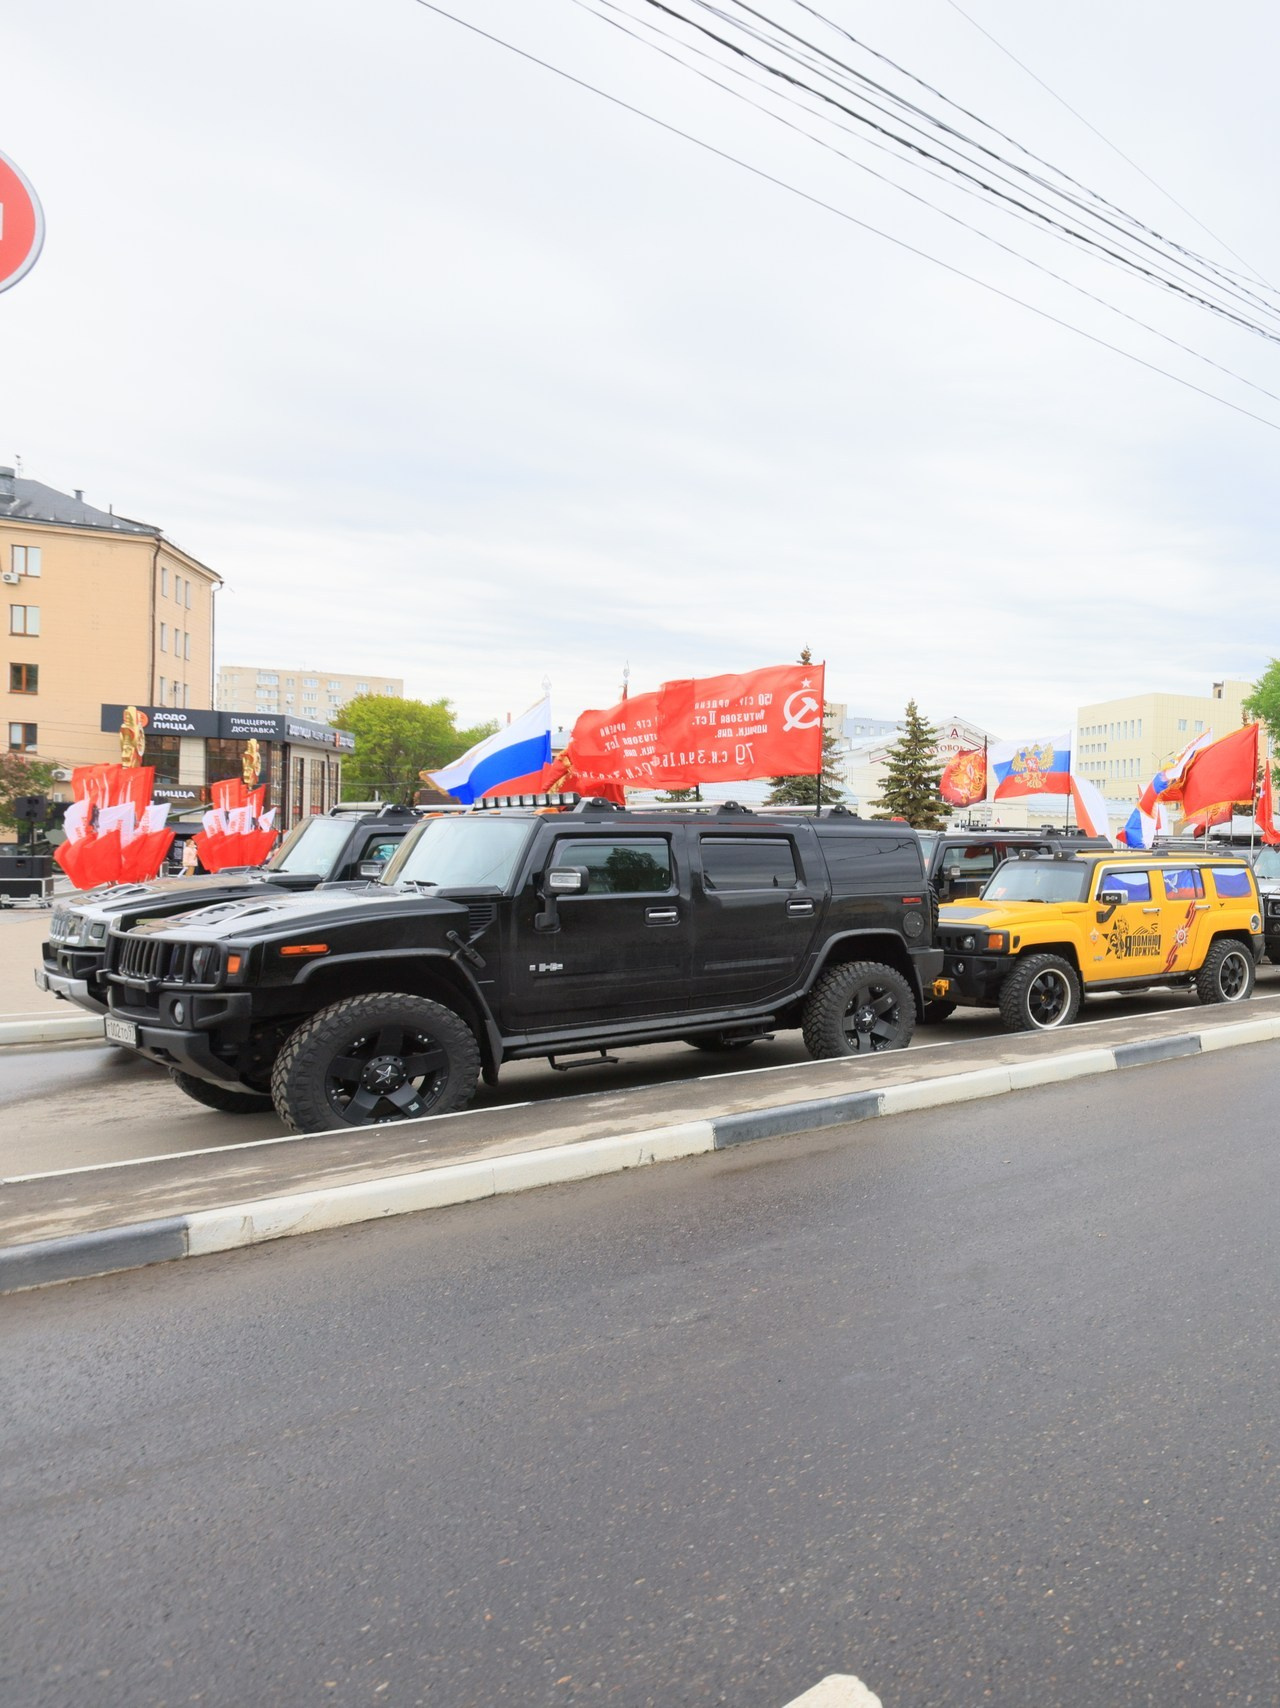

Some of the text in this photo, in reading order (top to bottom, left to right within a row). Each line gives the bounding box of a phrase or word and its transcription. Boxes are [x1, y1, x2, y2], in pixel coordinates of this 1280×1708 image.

[153, 712, 187, 722] ДОДО
[230, 717, 277, 727] ПИЦЦЕРИЯ
[153, 721, 196, 731] ПИЦЦА
[231, 725, 275, 734] ДОСТАВКА
[154, 789, 196, 799] ПИЦЦА
